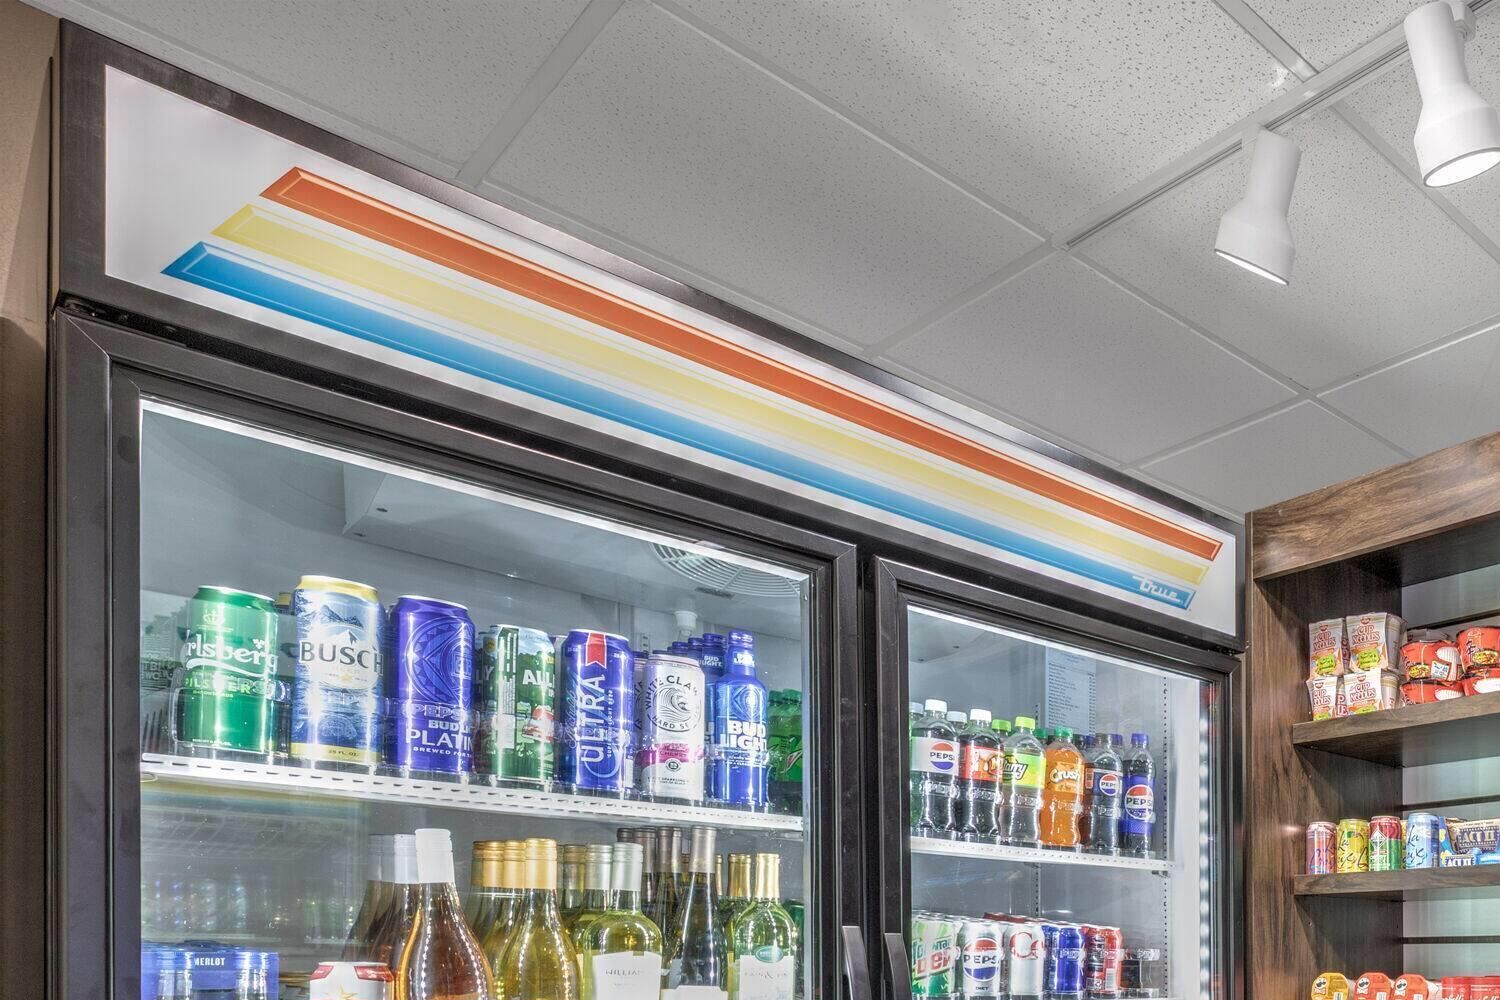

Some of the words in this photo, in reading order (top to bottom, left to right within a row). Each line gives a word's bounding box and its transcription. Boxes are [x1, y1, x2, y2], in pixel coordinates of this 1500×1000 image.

[1359, 625, 1374, 634] CUP
[1352, 632, 1380, 645] NOODLES
[300, 641, 384, 675] BUSCH
[646, 678, 664, 709] WHITE
[666, 675, 697, 696] CLAW
[1356, 682, 1370, 690] CUP
[1350, 689, 1376, 701] NOODLES
[581, 675, 605, 763] ULTRA
[652, 716, 675, 729] HARD
[727, 720, 766, 736] BUD
[413, 746, 450, 755] BREWED
[1050, 768, 1080, 783] Crush
[1462, 833, 1482, 842] ACT
